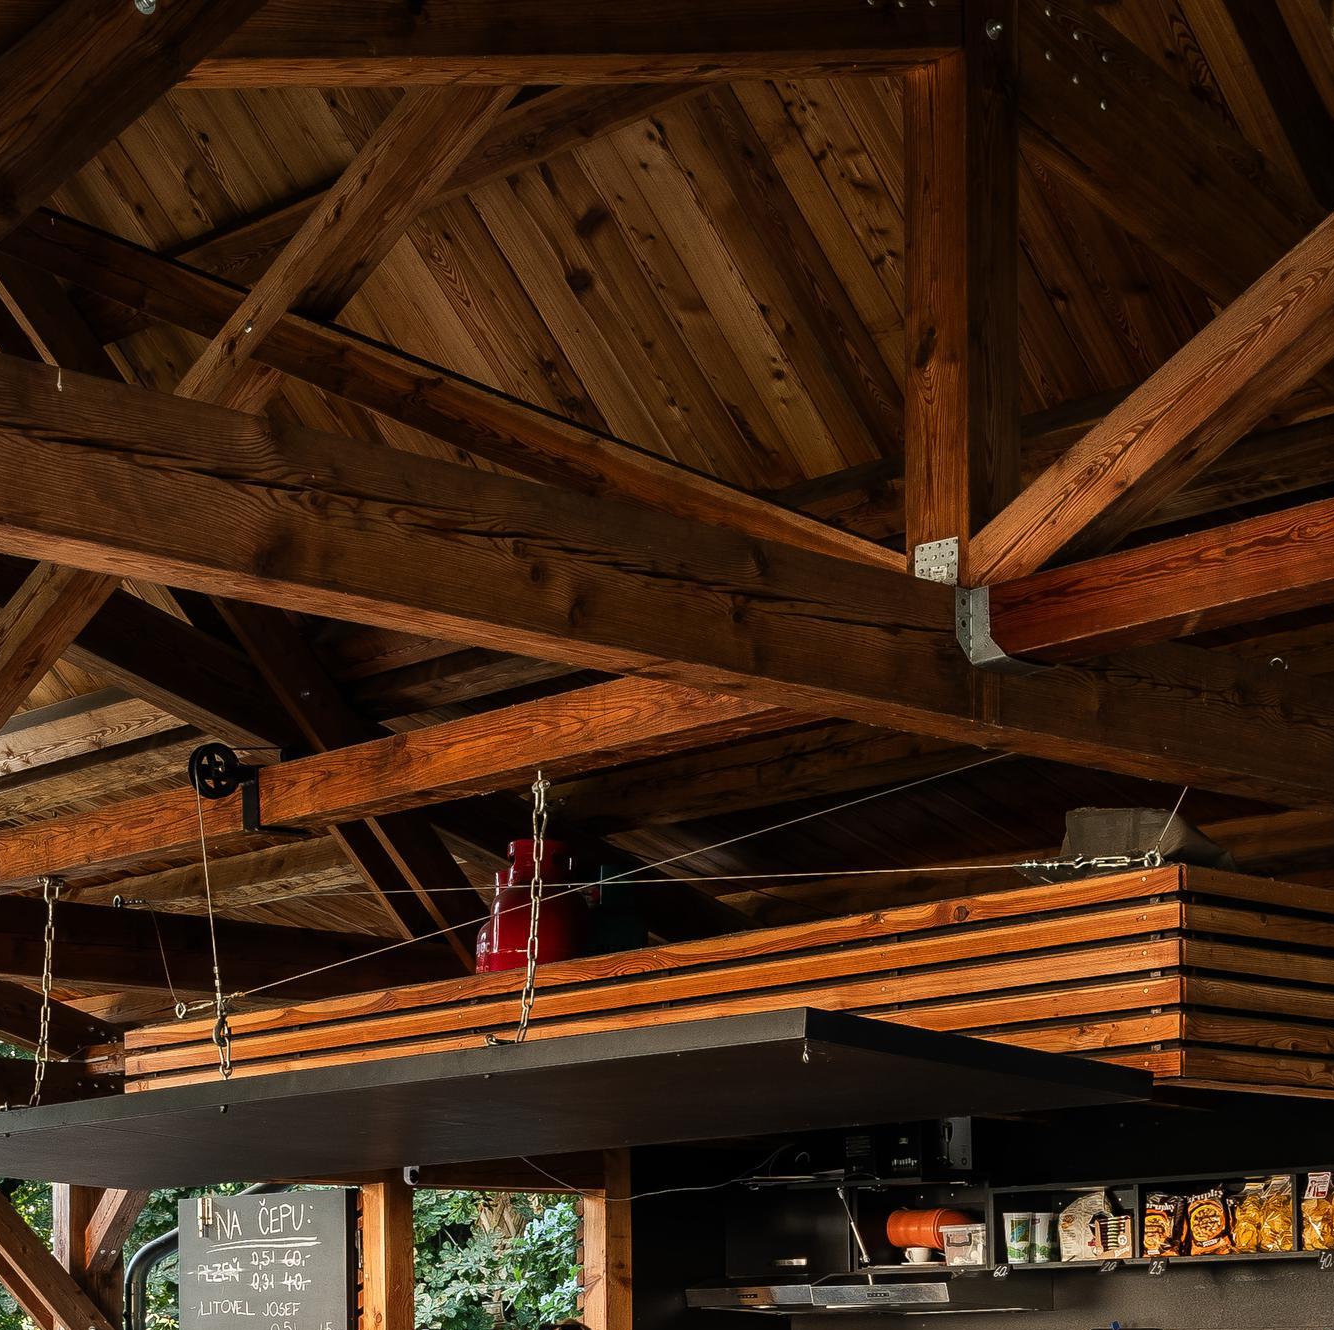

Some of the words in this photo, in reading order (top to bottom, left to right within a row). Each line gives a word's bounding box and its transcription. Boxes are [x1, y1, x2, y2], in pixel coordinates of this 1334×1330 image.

[215, 1208, 243, 1241] NA
[200, 1300, 255, 1316] LITOVEL
[262, 1301, 301, 1317] JOSEF
